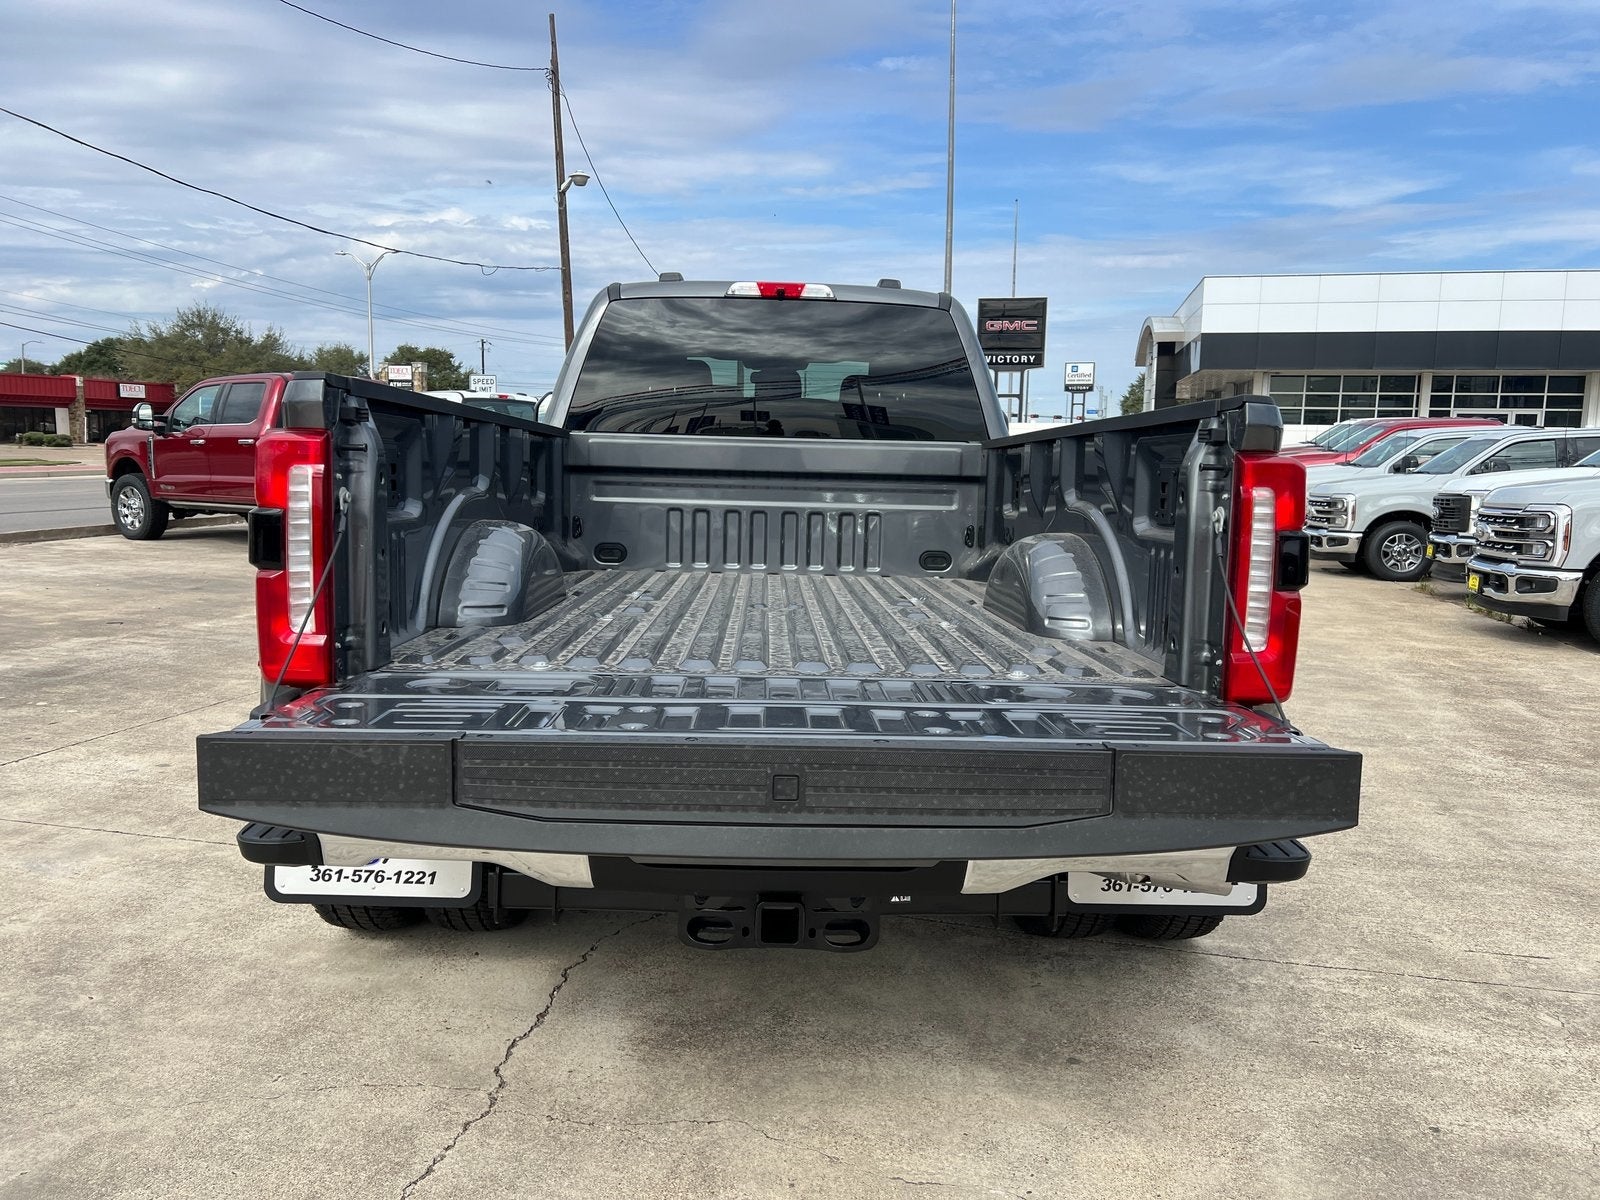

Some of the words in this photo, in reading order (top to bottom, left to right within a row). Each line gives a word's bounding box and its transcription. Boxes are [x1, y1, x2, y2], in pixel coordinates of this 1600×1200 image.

[985, 320, 1038, 331] GMC
[984, 355, 1036, 363] VICTORY
[309, 868, 437, 885] 361-576-1221
